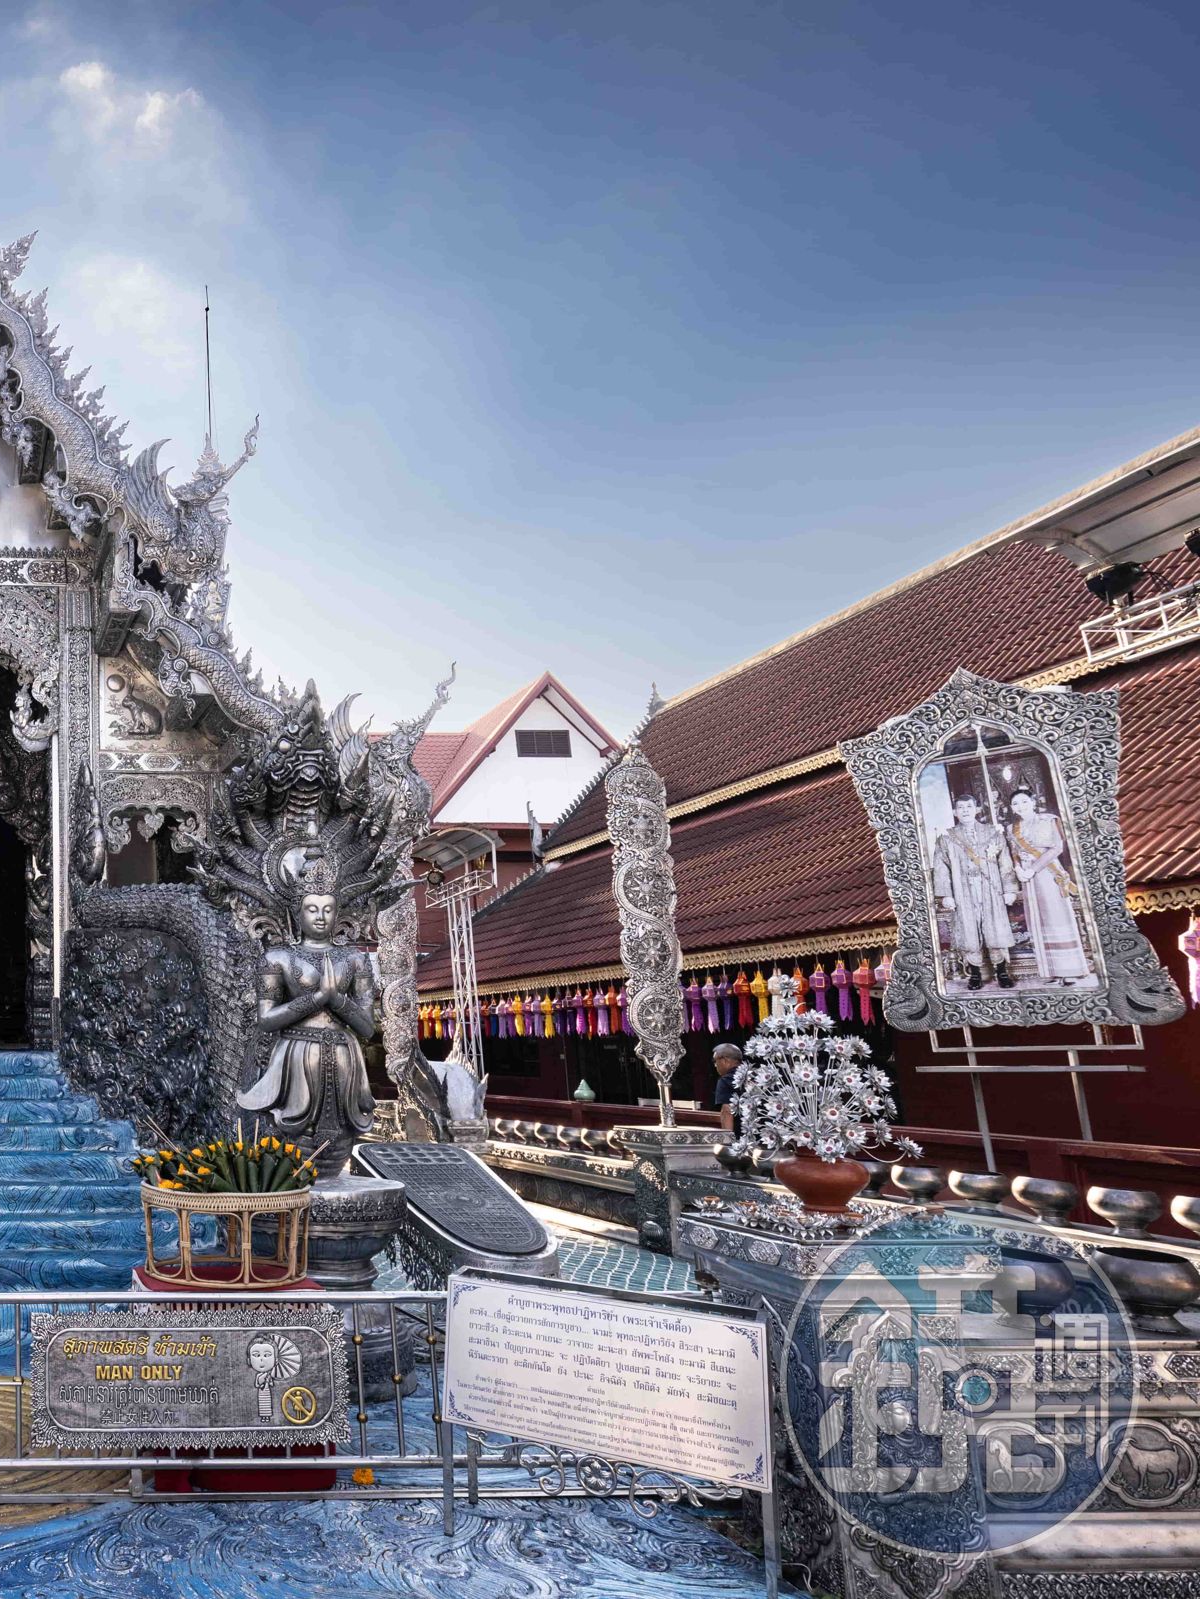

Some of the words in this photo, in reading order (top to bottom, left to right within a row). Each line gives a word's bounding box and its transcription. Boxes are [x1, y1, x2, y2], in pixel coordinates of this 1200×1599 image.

[64, 1336, 150, 1360] สุภาพสตรี
[155, 1334, 216, 1357] ห้ามเข้า
[96, 1365, 132, 1380] MAN
[141, 1365, 182, 1380] ONLY
[573, 1370, 593, 1380] ปะนะ
